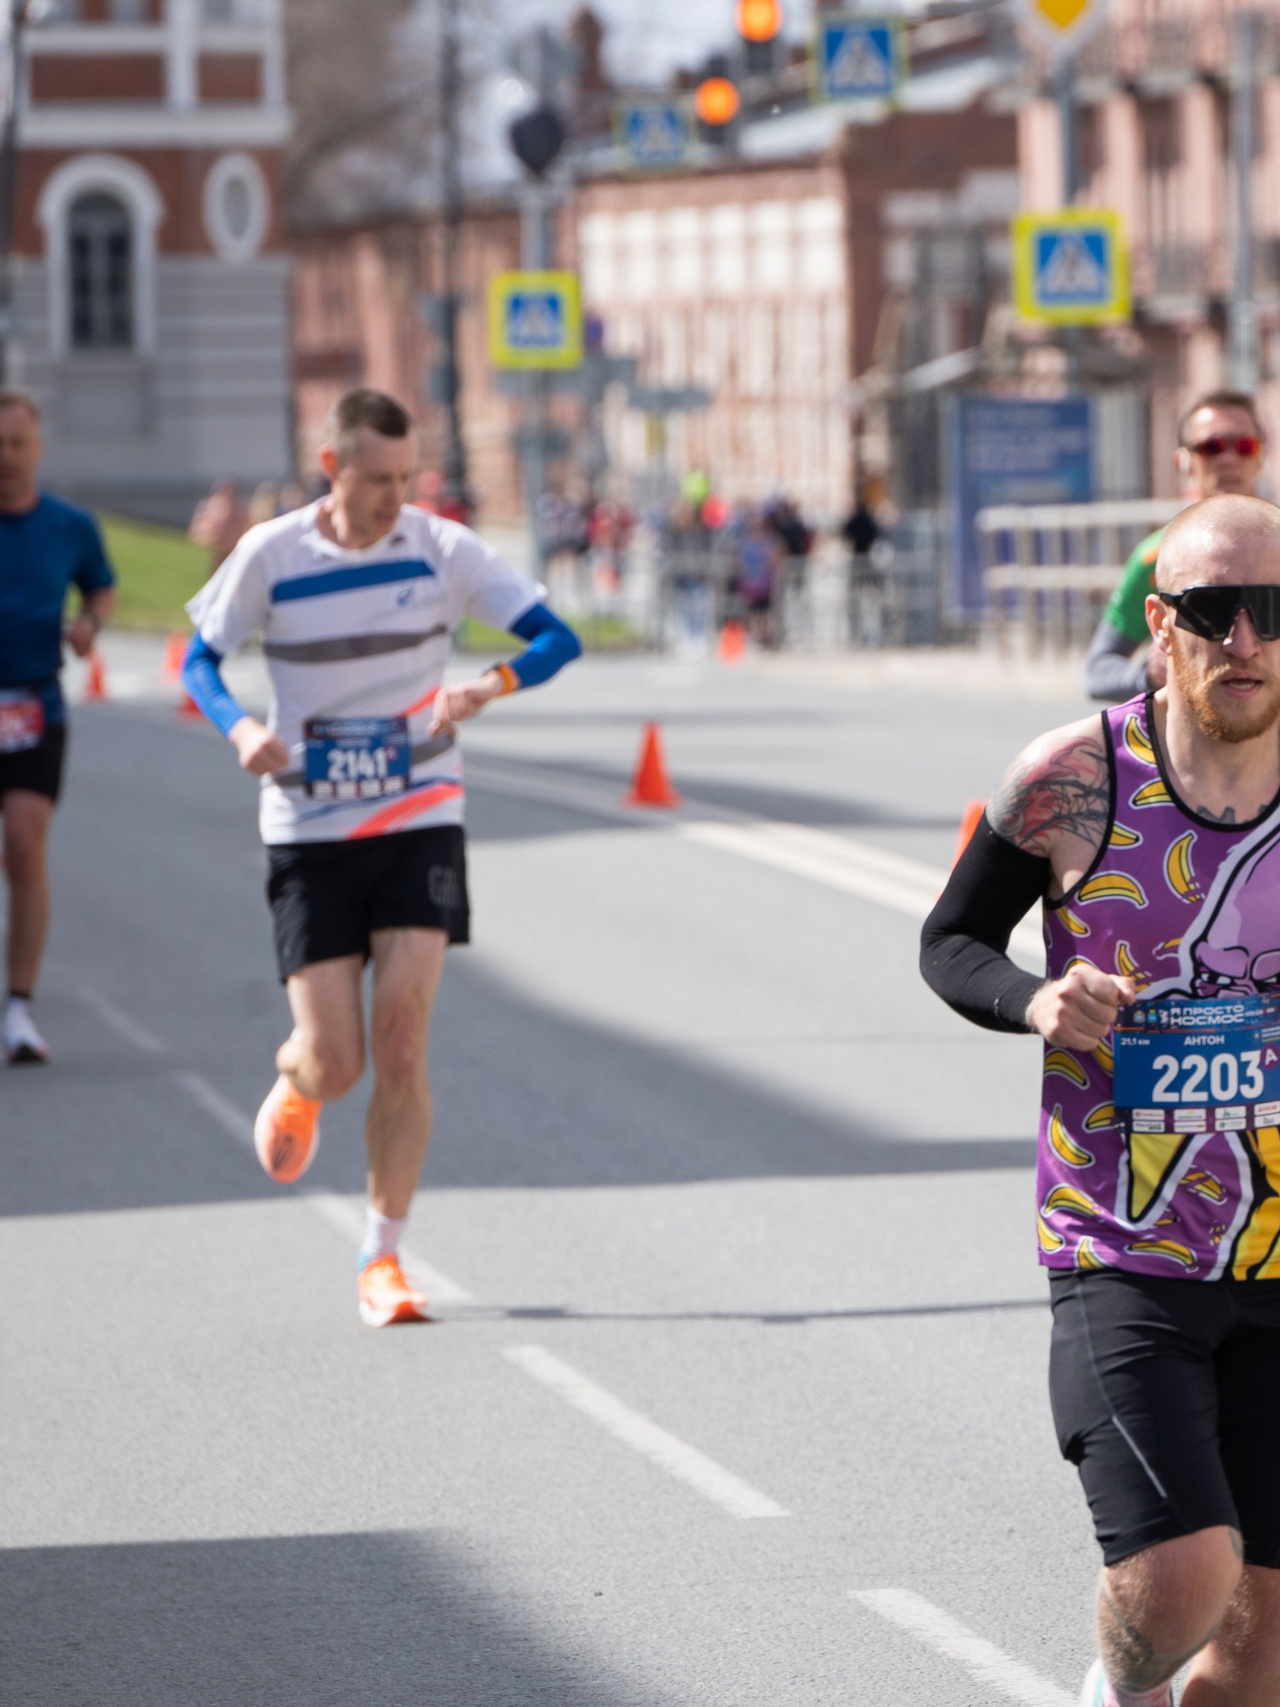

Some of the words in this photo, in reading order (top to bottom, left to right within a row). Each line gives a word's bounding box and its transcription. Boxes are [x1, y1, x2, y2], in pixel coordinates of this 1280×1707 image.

[327, 748, 387, 780] 2141
[1170, 1007, 1182, 1016] Я
[1182, 1005, 1244, 1015] ПРОСТО
[1170, 1013, 1244, 1026] КОСМОС
[1184, 1034, 1224, 1046] АНТОН
[1152, 1050, 1264, 1103] 2203
